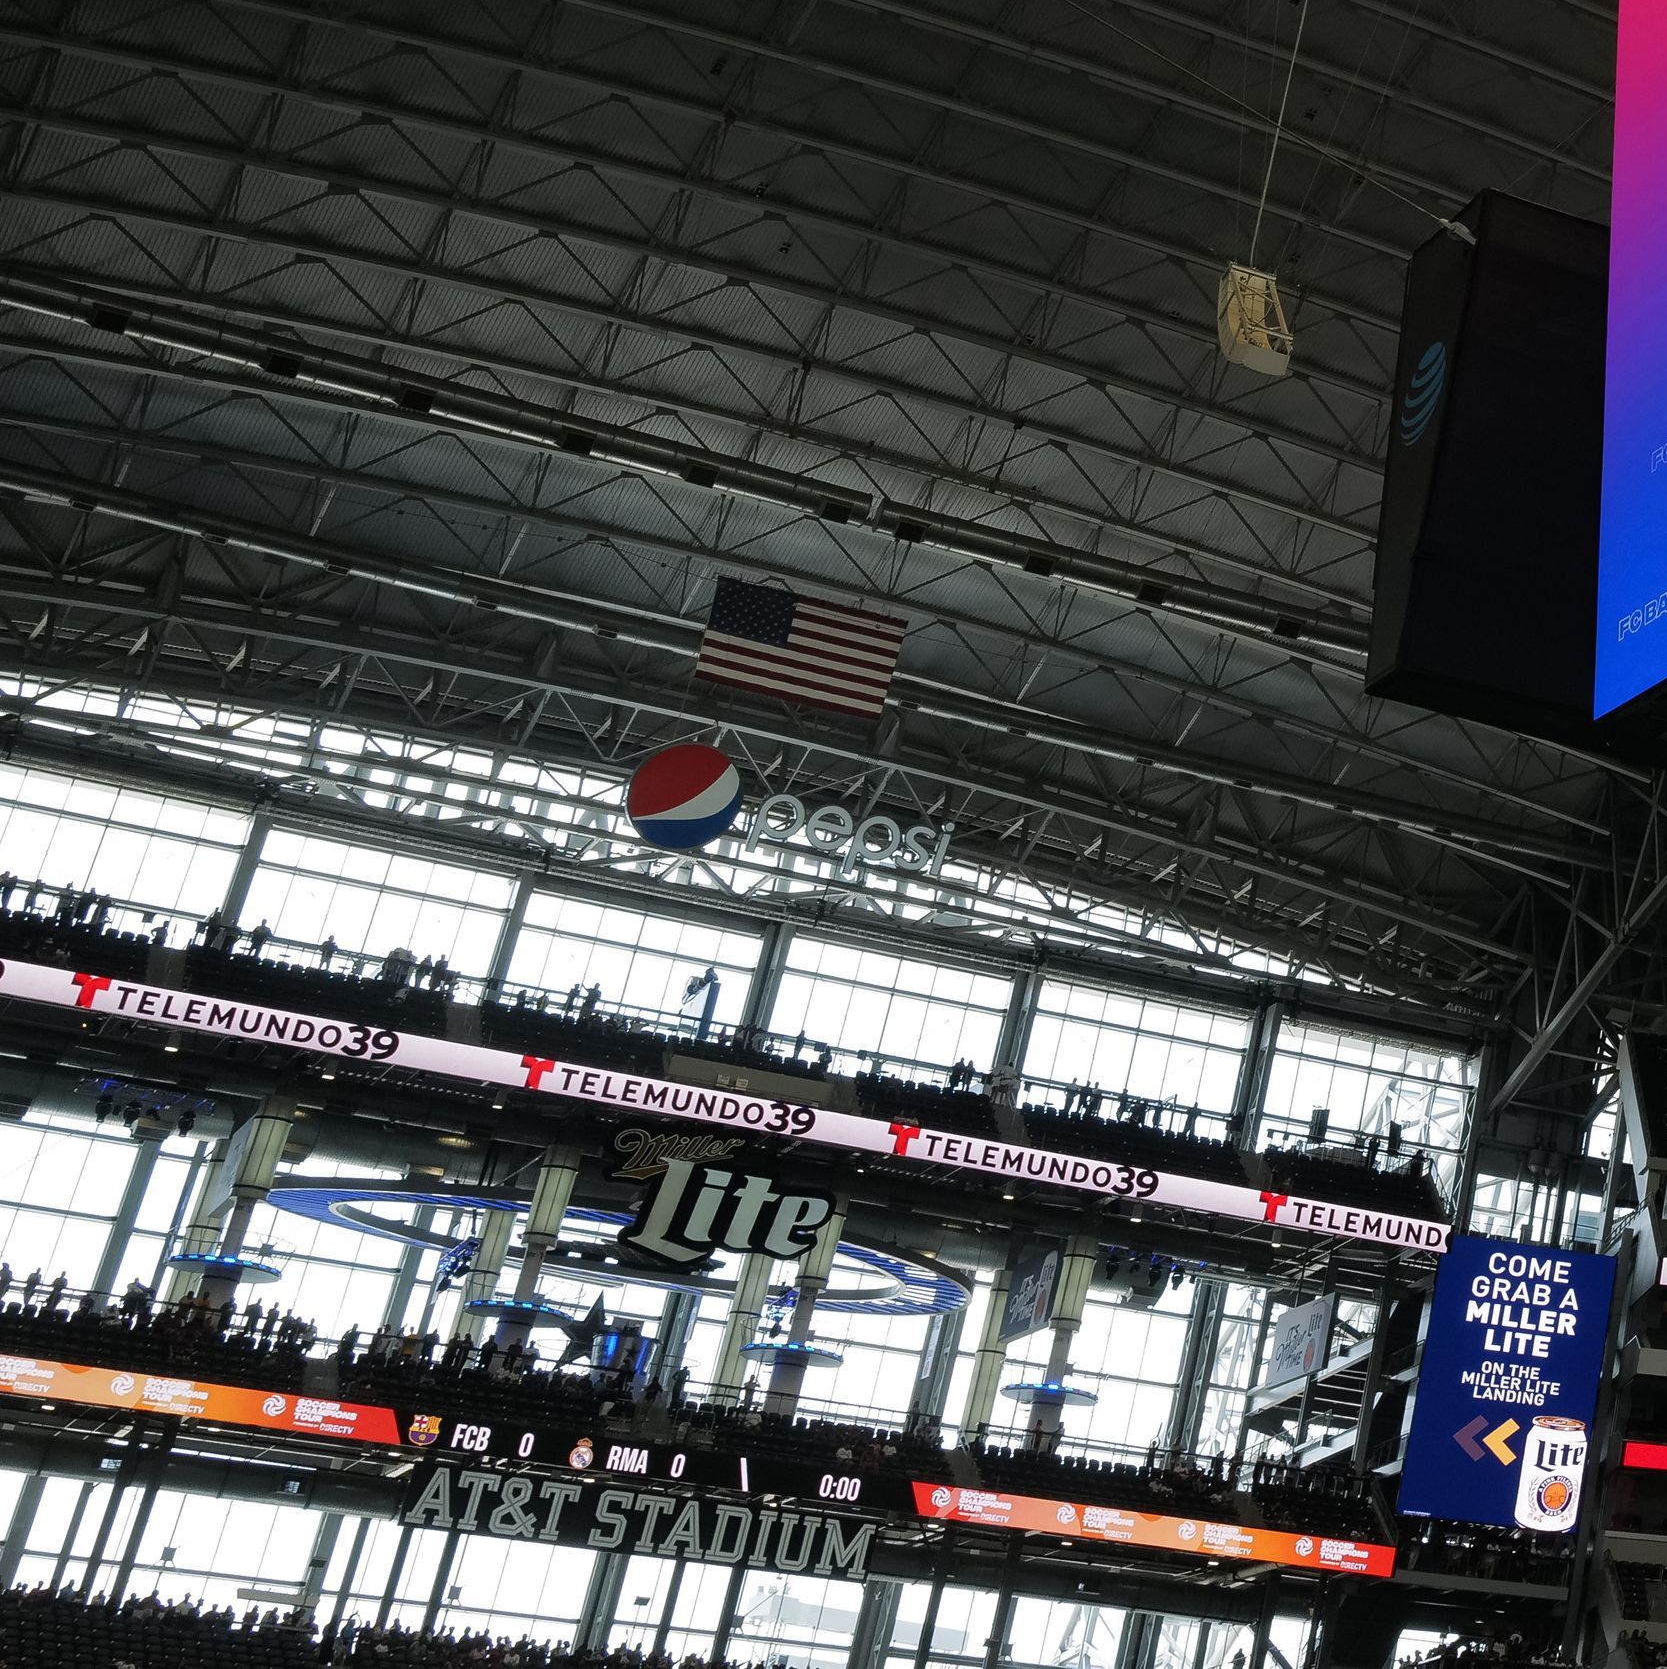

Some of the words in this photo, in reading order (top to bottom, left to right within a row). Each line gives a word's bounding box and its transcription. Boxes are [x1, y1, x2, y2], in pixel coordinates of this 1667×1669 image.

[1618, 613, 1643, 642] FC
[746, 794, 956, 875] pepsi
[614, 1128, 746, 1171] Miller
[627, 1158, 829, 1262] Lite
[1488, 1252, 1572, 1283] COME
[1471, 1275, 1551, 1306] GRAB
[1559, 1288, 1579, 1311] A
[1465, 1300, 1577, 1335] MILLER
[1483, 1328, 1551, 1358] LITE
[1461, 1370, 1520, 1391] MILLER
[1526, 1379, 1560, 1396] LITE
[1481, 1361, 1504, 1376] ON
[1509, 1364, 1540, 1380] THE
[1472, 1389, 1545, 1406] LANDING
[451, 1423, 491, 1451] FCB
[518, 1433, 534, 1457] 0
[606, 1446, 648, 1474] RMA
[670, 1454, 686, 1478] 0
[819, 1474, 861, 1501] 0:00
[1534, 1439, 1584, 1472] Lite
[405, 1467, 583, 1542] AT&T
[587, 1489, 877, 1580] STADIUM
